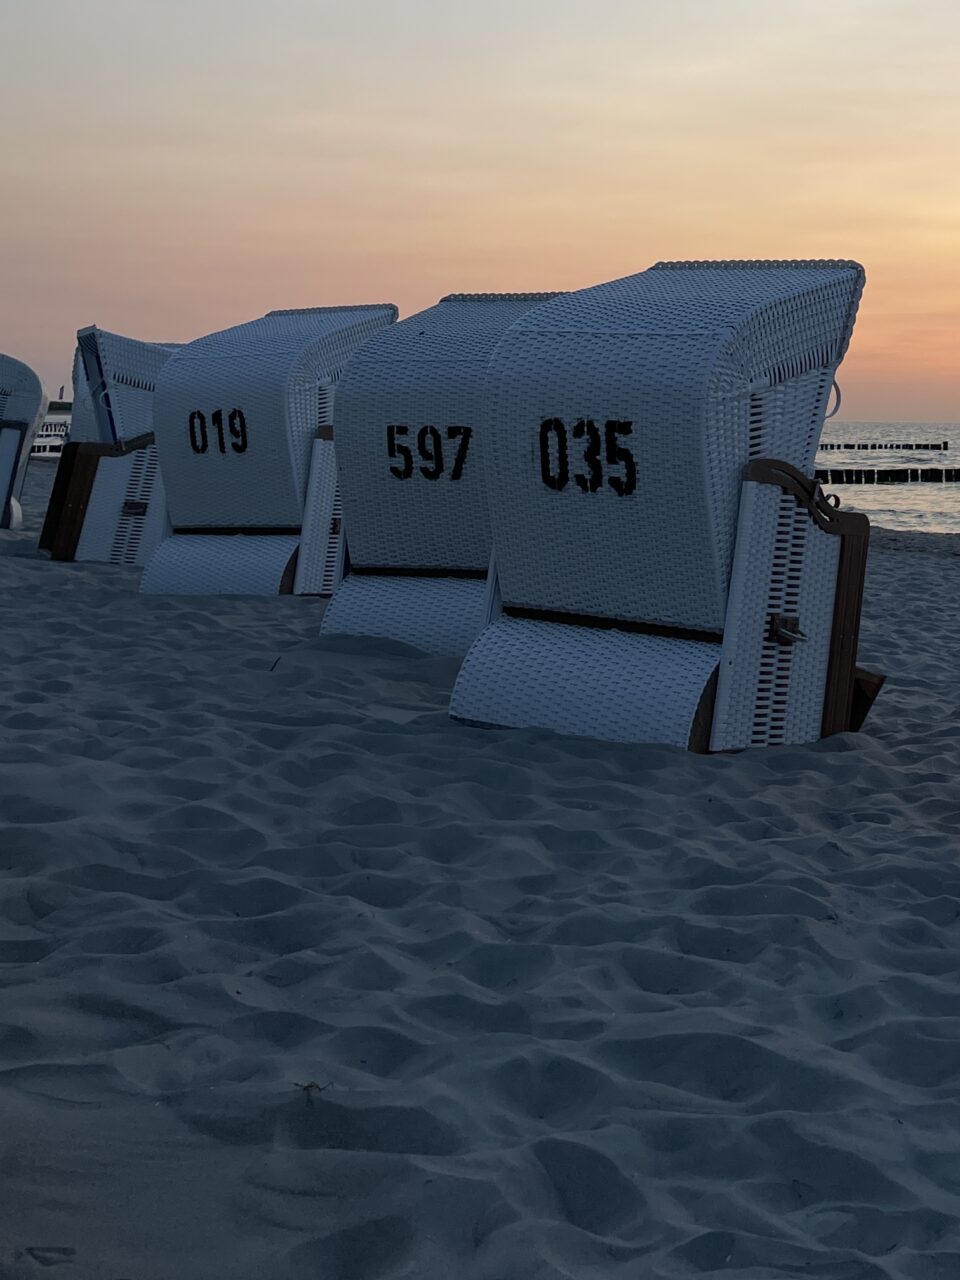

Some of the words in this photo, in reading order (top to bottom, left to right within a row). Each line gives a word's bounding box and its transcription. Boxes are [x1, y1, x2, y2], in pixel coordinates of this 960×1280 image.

[189, 408, 248, 454] 019
[387, 425, 473, 481] 597
[540, 417, 638, 496] 035
